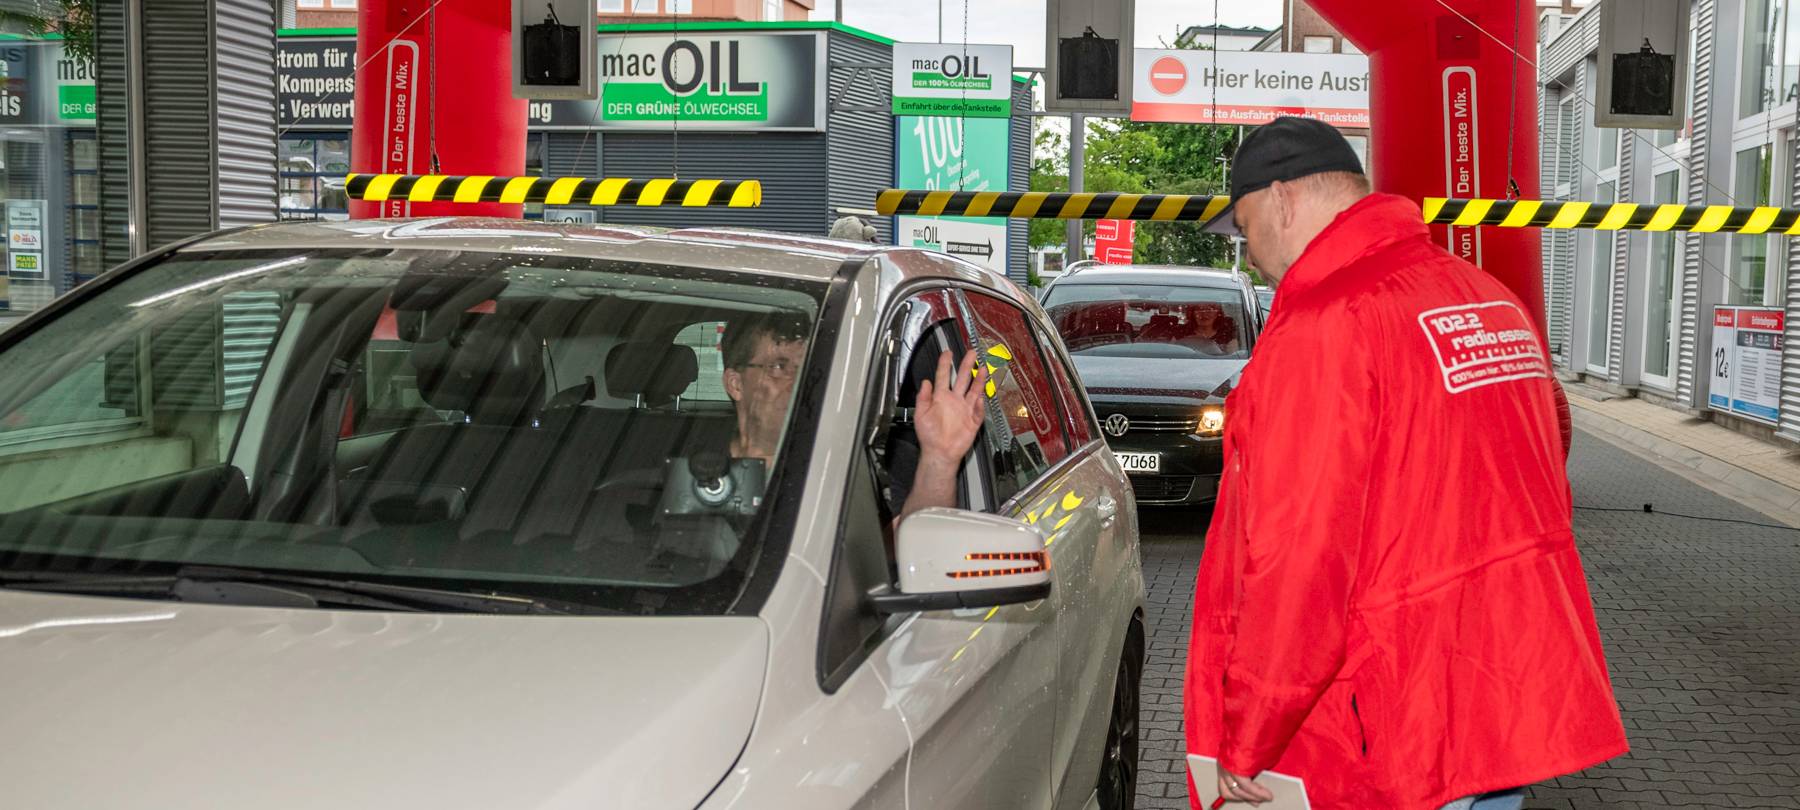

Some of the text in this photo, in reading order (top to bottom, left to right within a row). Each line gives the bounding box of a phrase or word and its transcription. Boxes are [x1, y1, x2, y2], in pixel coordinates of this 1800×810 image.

[323, 48, 348, 67] für
[602, 40, 760, 93] mac OIL
[912, 55, 988, 78] mac OIL
[280, 74, 354, 97] Kompens
[395, 61, 408, 89] Mix.
[1203, 67, 1249, 88] Hier
[1254, 69, 1314, 91] keine
[0, 90, 21, 116] is
[62, 104, 81, 114] DER
[393, 93, 406, 132] beste
[608, 100, 761, 115] DER GRÜNE ÖLWECHSEL
[901, 102, 931, 110] Einfahrt
[933, 103, 951, 111] über
[1454, 87, 1467, 118] Mix.
[1203, 108, 1228, 119] Bitte
[1230, 109, 1275, 121] Ausfahrt
[391, 136, 404, 162] Der
[1456, 122, 1468, 162] beste
[1457, 167, 1470, 193] Der
[1461, 233, 1471, 257] von
[1430, 313, 1483, 335] 102.2
[1451, 329, 1498, 350] radio
[1121, 454, 1157, 469] 7068
